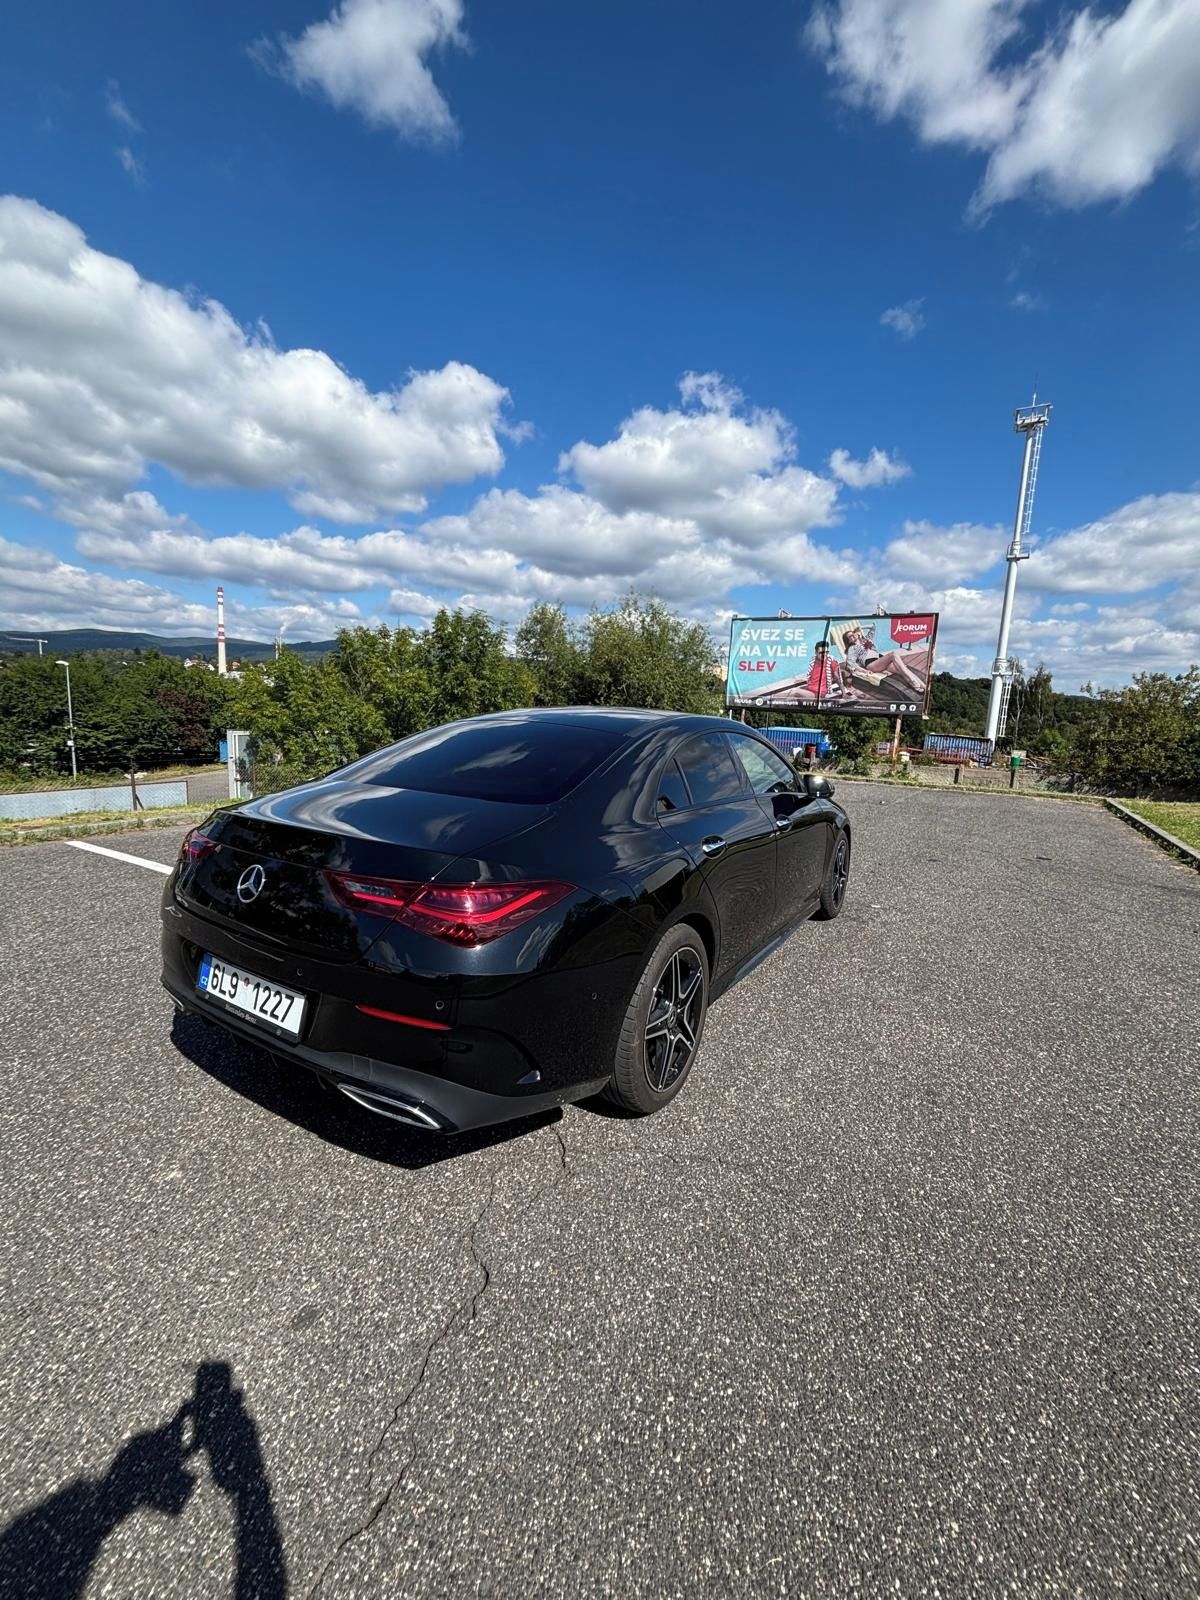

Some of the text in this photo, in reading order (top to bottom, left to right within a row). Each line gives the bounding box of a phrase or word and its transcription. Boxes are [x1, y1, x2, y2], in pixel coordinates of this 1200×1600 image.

[741, 628, 805, 641] SVEZ SE
[740, 642, 808, 657] NA VLNĚ
[738, 660, 777, 672] SLEV
[210, 963, 295, 1023] 6L9 1227
